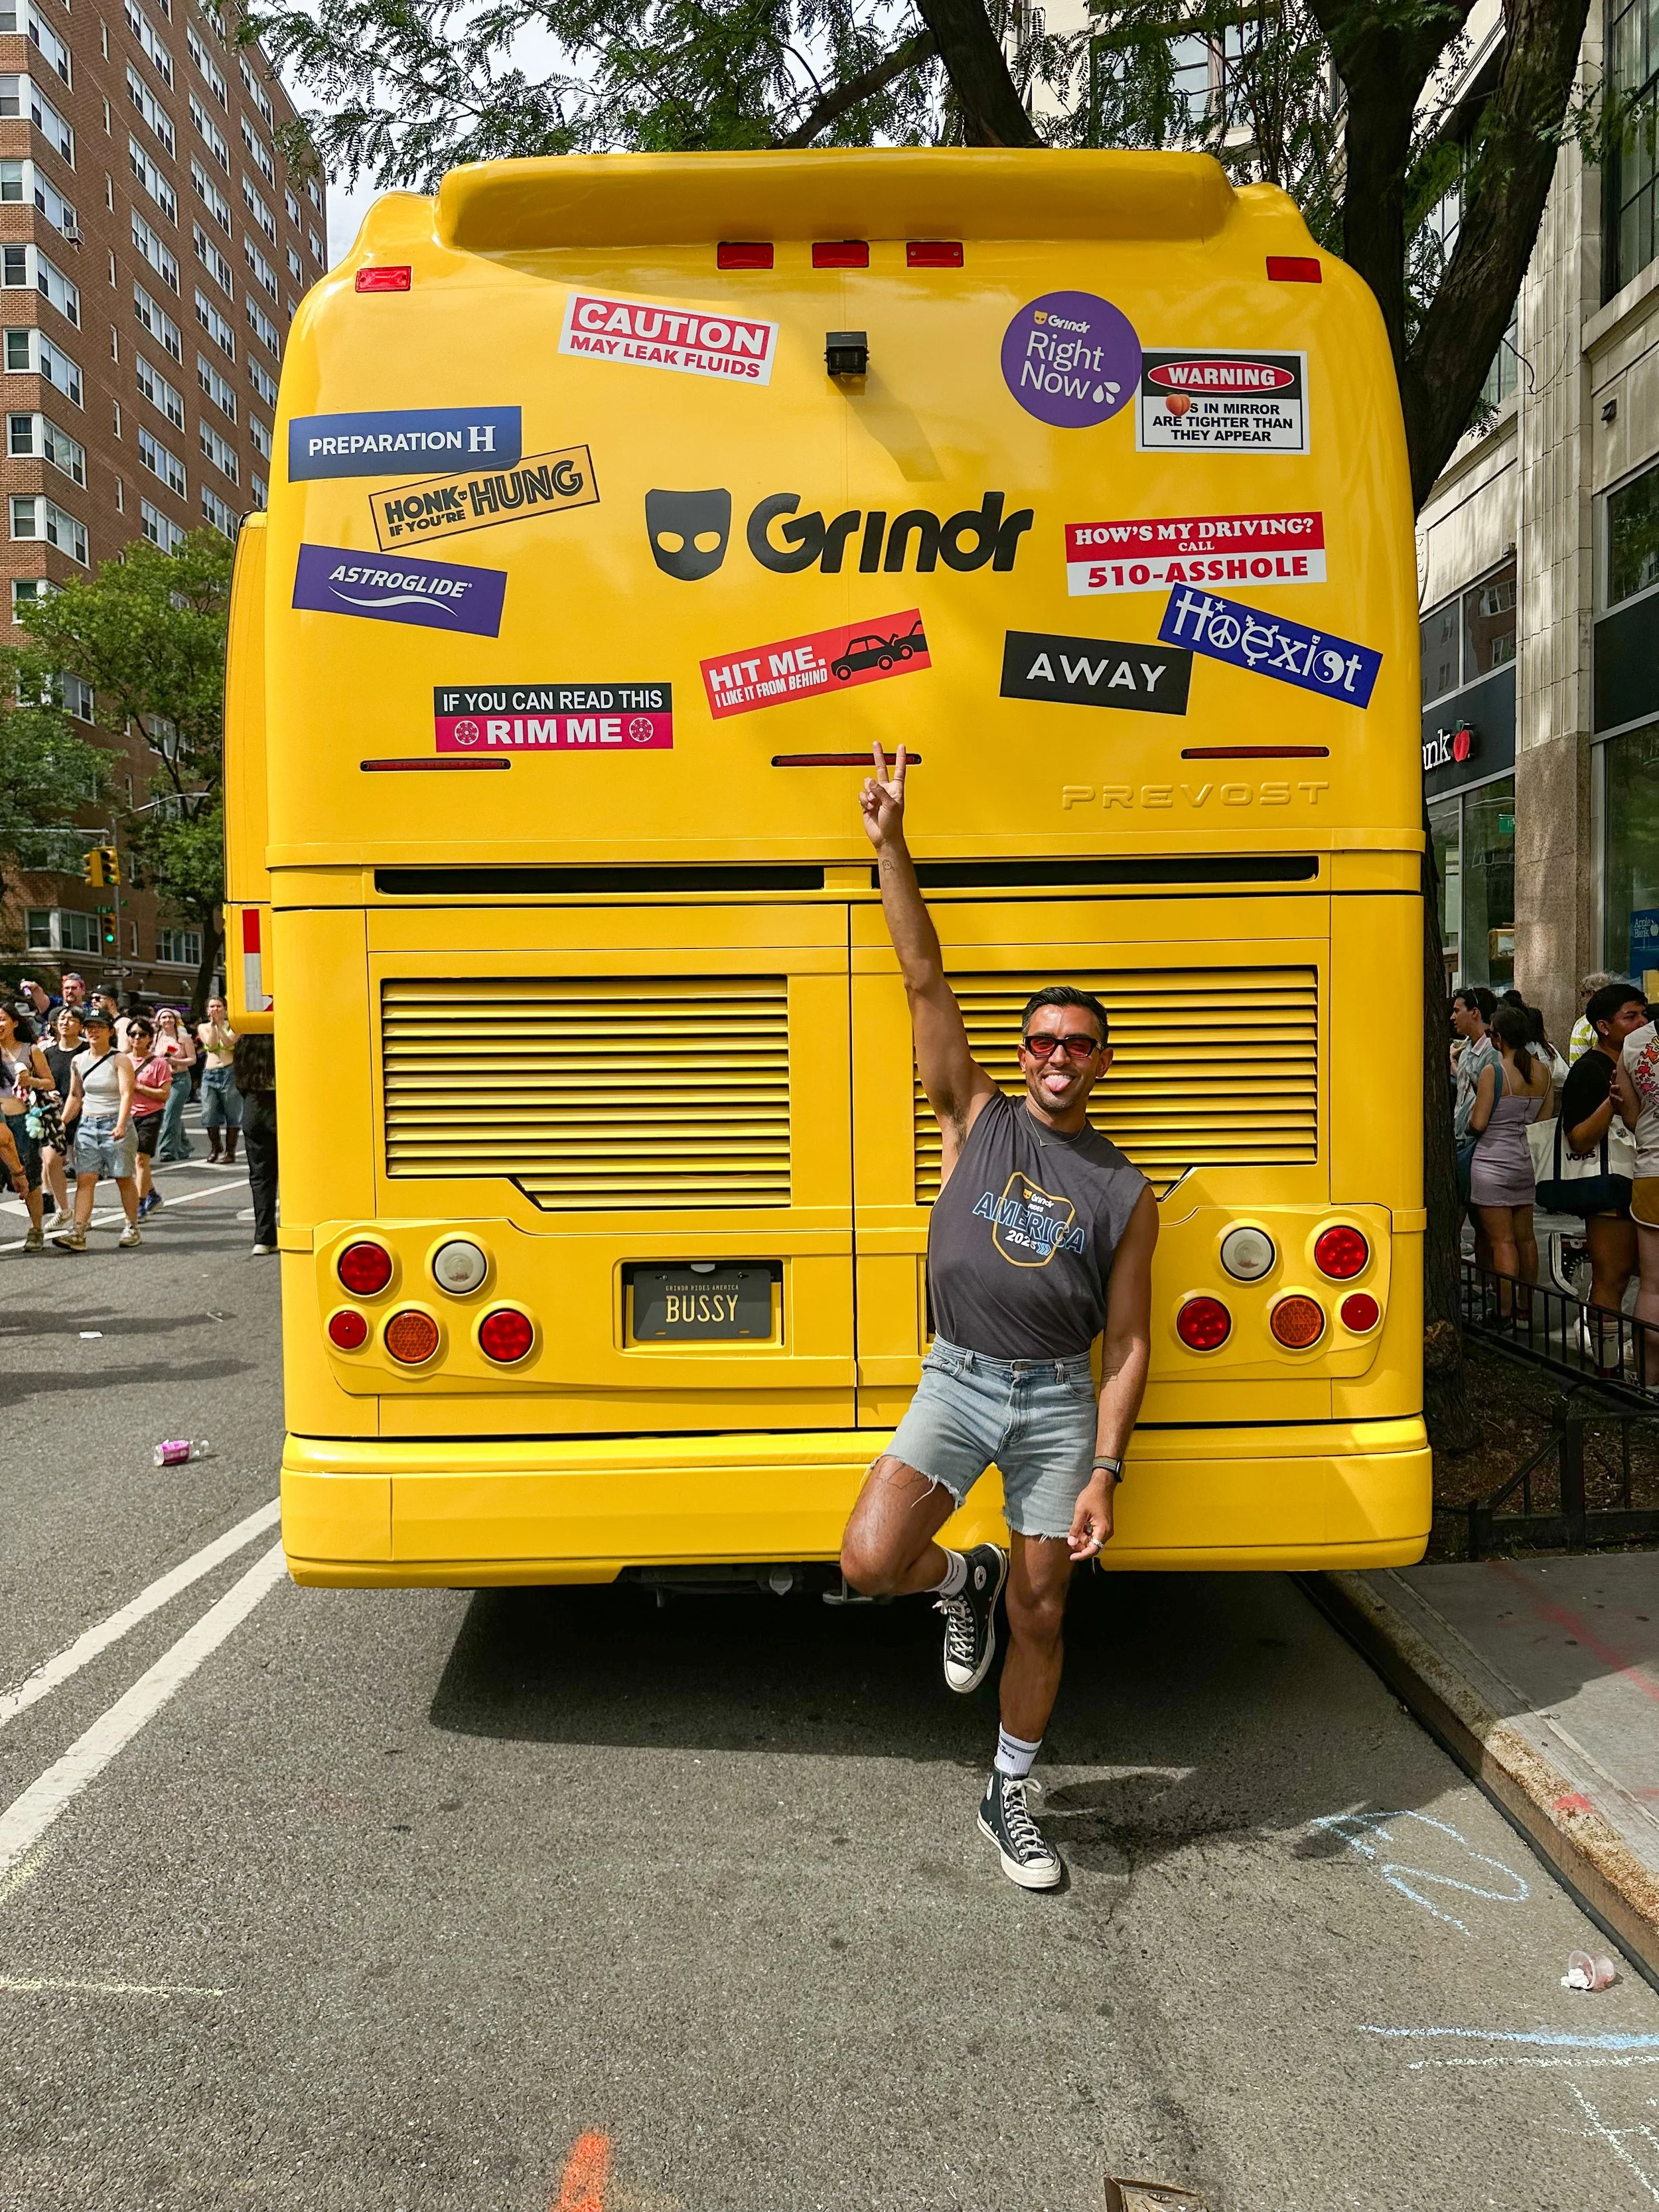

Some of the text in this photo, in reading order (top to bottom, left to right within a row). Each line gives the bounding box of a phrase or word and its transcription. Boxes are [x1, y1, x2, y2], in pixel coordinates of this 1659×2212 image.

[578, 303, 765, 355] CAUTION
[1048, 315, 1091, 334] Grindr
[570, 335, 760, 378] MAY LEAK FLUIDS
[1027, 331, 1105, 372] Right
[1021, 360, 1090, 400] Now
[1168, 367, 1275, 386] WARNING
[1153, 415, 1293, 429] ARE TIGHTER THAN
[1204, 403, 1219, 413] IN
[1224, 404, 1280, 415] MIRROR
[309, 425, 496, 457] PREPARATION H
[1171, 429, 1271, 442] THEY APPEAR
[468, 459, 584, 516] HUNG
[385, 485, 462, 525] HONK
[389, 509, 466, 538] IF YOU'RE
[747, 491, 1035, 573] Grindr
[1075, 517, 1315, 546] HOW'S MY DRIVING?
[1178, 541, 1215, 552] CALL
[1088, 556, 1309, 588] 510-ASSHOLE
[709, 646, 827, 692] HIT ME.
[1026, 652, 1167, 692] AWAY
[443, 690, 663, 711] IF YOU CAN READ THIS
[715, 668, 828, 708] I LIKE IT FROM BEHIND
[486, 718, 622, 745] RIM ME
[1062, 781, 1329, 811] PREVOST
[1634, 917, 1651, 929] Apple
[1634, 928, 1650, 938] Bank
[972, 1191, 1084, 1254] AMERICA
[1028, 1204, 1044, 1213] RIDES
[1005, 1230, 1037, 1250] 2025
[666, 1294, 739, 1323] BUSSY
